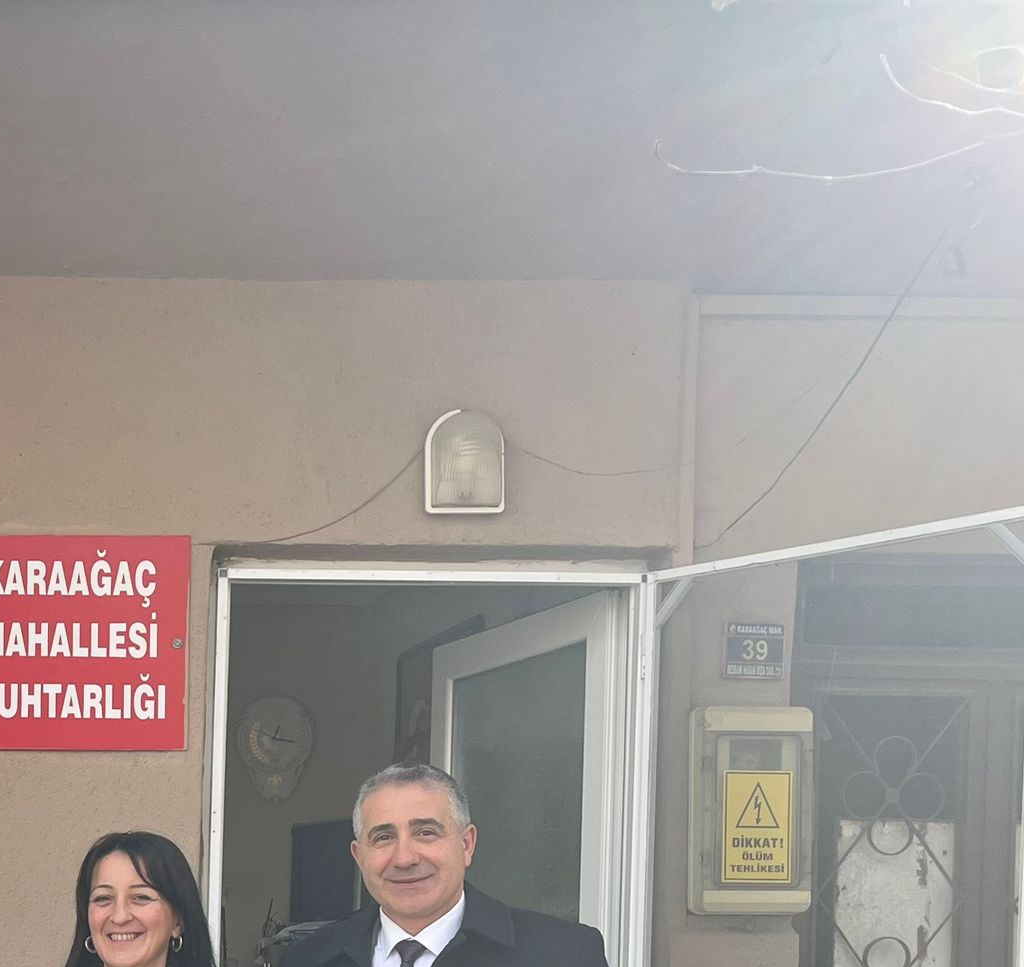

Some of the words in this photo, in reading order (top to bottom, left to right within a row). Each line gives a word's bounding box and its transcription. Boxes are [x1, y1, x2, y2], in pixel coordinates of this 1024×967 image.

[742, 639, 768, 661] 39
[732, 835, 784, 849] DİKKAT!
[742, 851, 773, 861] ÖLÜM
[730, 863, 784, 873] TEHLİKESİ
